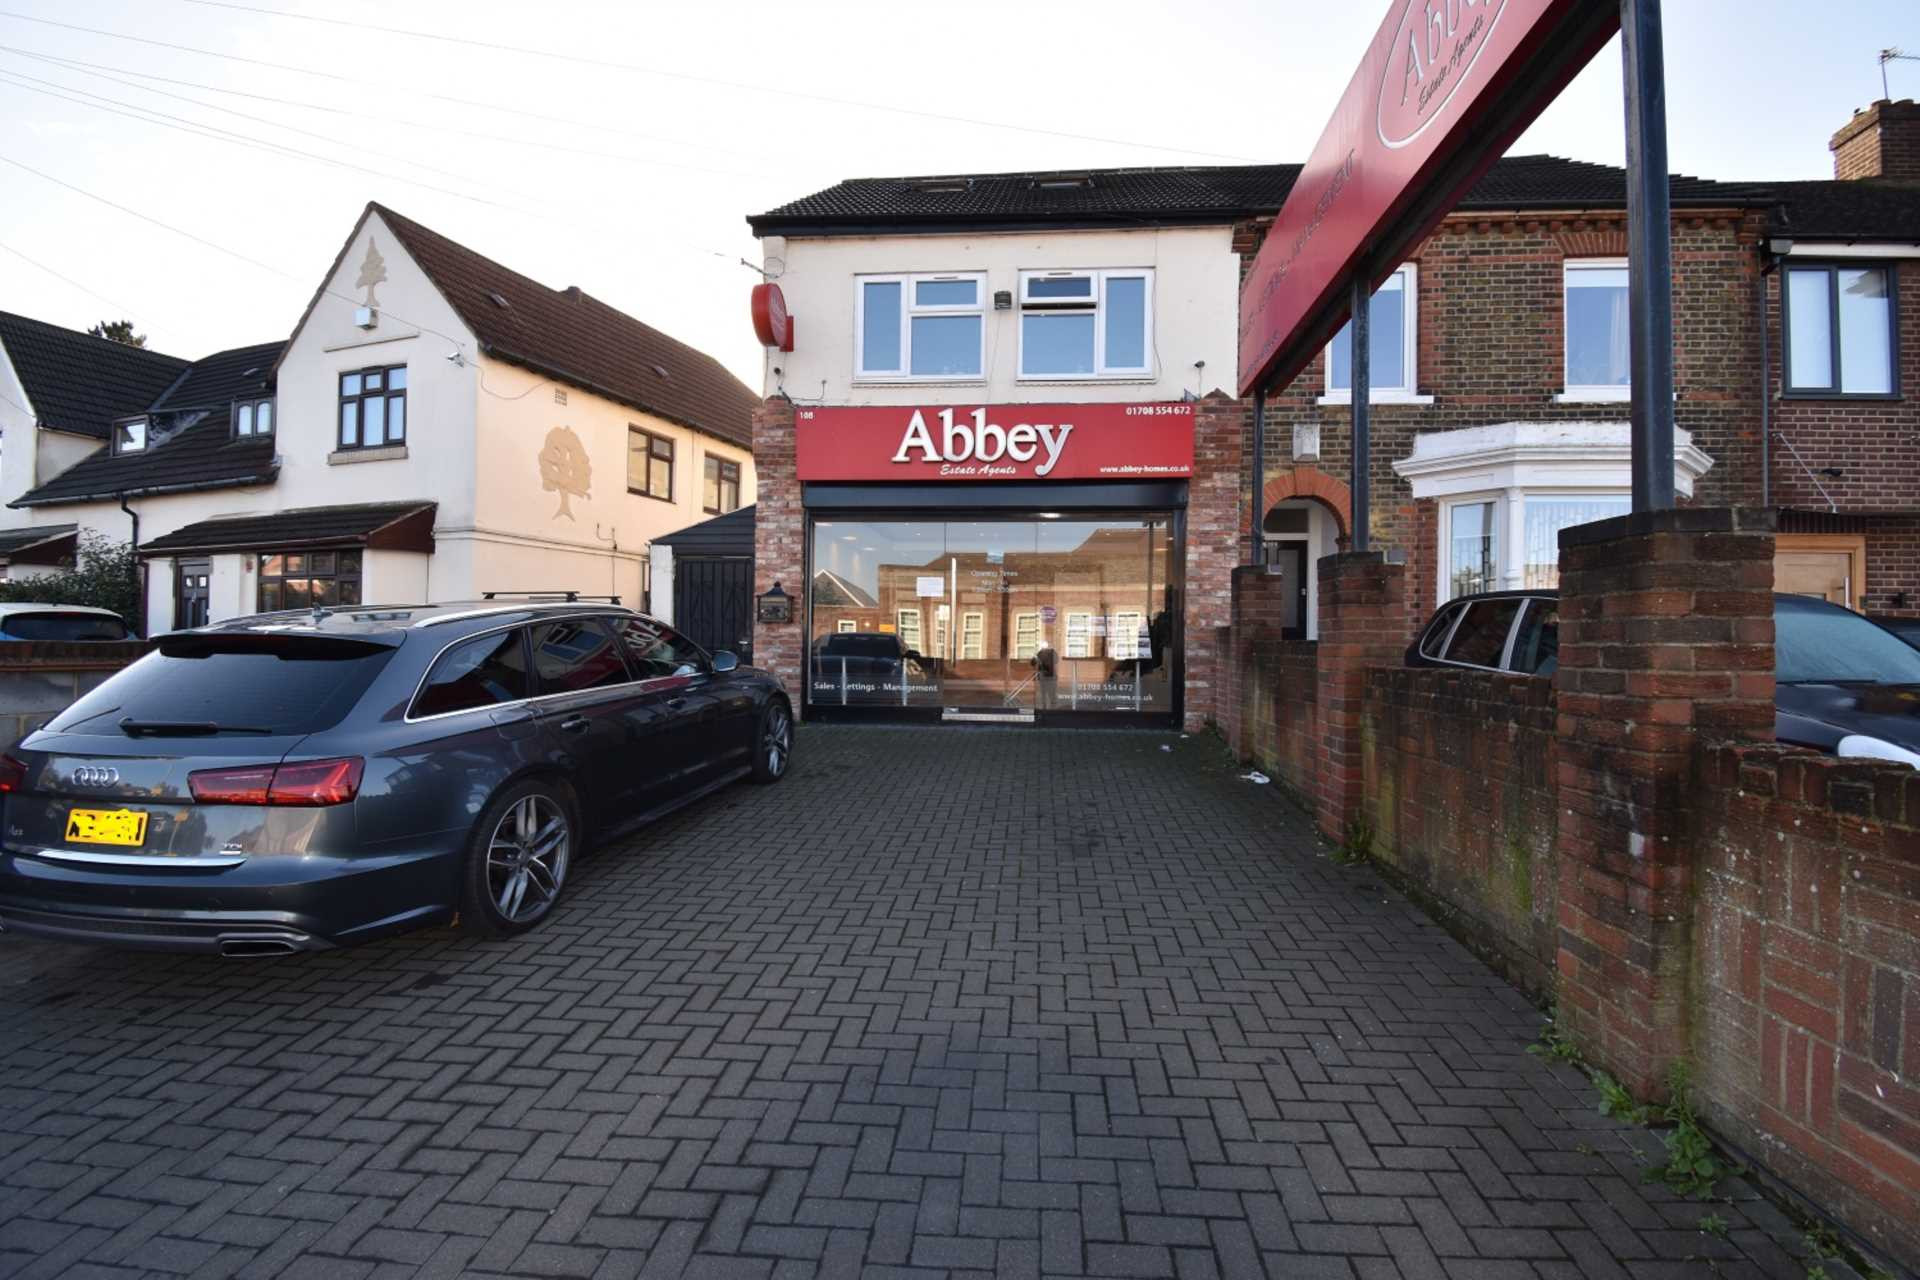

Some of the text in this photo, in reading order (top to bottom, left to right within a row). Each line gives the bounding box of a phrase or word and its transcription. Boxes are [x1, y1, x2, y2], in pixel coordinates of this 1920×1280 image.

[1417, 14, 1484, 115] Estate Agents
[1125, 406, 1191, 416] 01708 554 672
[891, 407, 1073, 476] Abbey
[940, 464, 1016, 477] Estate Agents
[1100, 464, 1190, 474] www.abbey-homes.co.uk
[813, 682, 835, 690] Sales
[842, 682, 875, 692] Lettings
